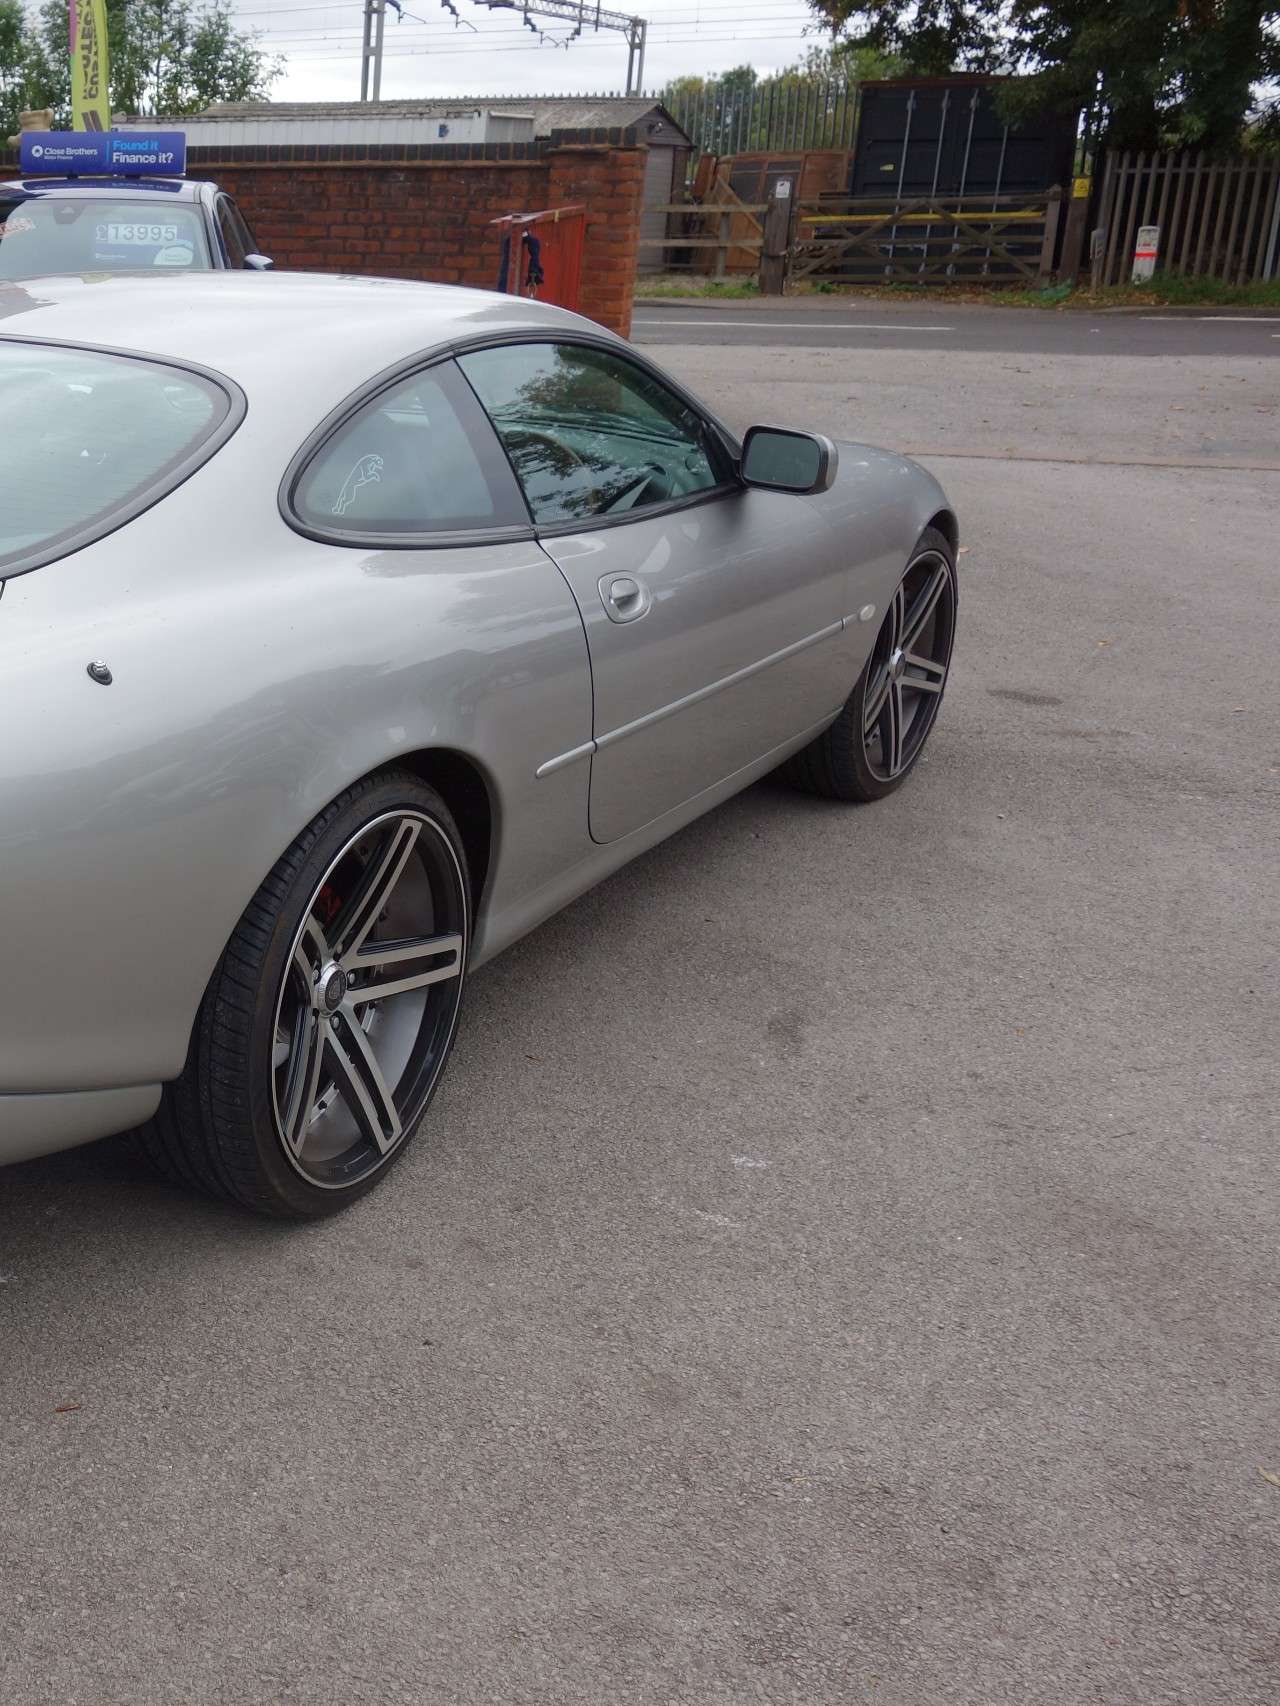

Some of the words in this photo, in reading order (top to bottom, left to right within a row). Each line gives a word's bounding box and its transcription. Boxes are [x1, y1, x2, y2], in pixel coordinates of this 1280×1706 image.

[112, 139, 149, 151] Found
[150, 140, 160, 151] it
[44, 148, 65, 156] Close
[66, 147, 98, 156] Brothers
[112, 152, 157, 164] Finance
[158, 152, 174, 164] it?
